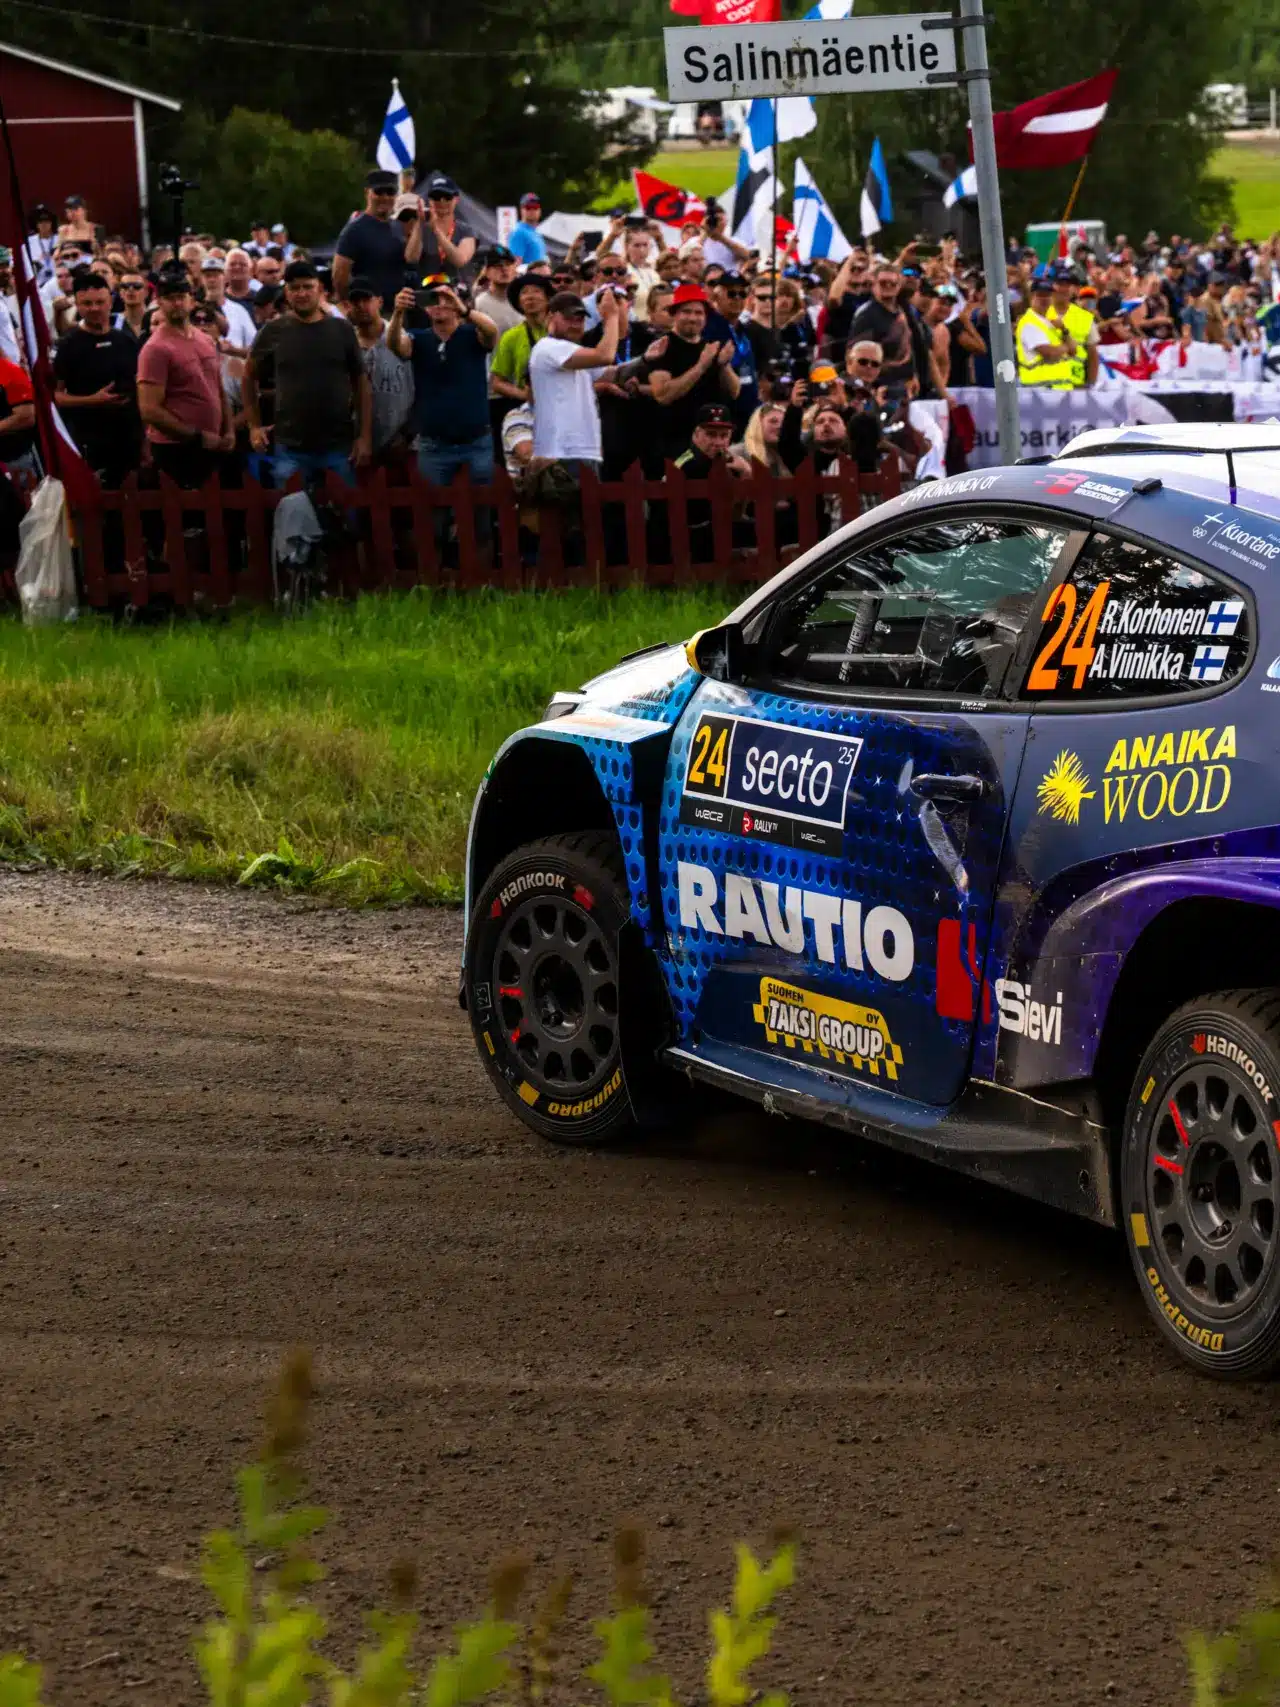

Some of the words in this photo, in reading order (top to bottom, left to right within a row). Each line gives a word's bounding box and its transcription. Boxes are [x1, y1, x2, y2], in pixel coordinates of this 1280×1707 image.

[684, 33, 939, 83] Salinmäentie
[1220, 523, 1280, 560] Kuortane
[1027, 580, 1110, 691] 24
[1100, 600, 1206, 636] R.Korhonen
[1088, 643, 1184, 681] A.Viinikka
[687, 722, 729, 791] 24
[1104, 725, 1237, 774] ANAIKA
[741, 745, 834, 808] secto
[1101, 764, 1232, 826] WOOD
[753, 819, 773, 834] RALLY
[677, 861, 915, 982] RAUTIO
[767, 982, 804, 1003] SUOMEN
[995, 978, 1062, 1046] Sievi
[768, 998, 817, 1041] TAKSI
[818, 1015, 884, 1060] GROUP
[866, 1013, 880, 1025] OY
